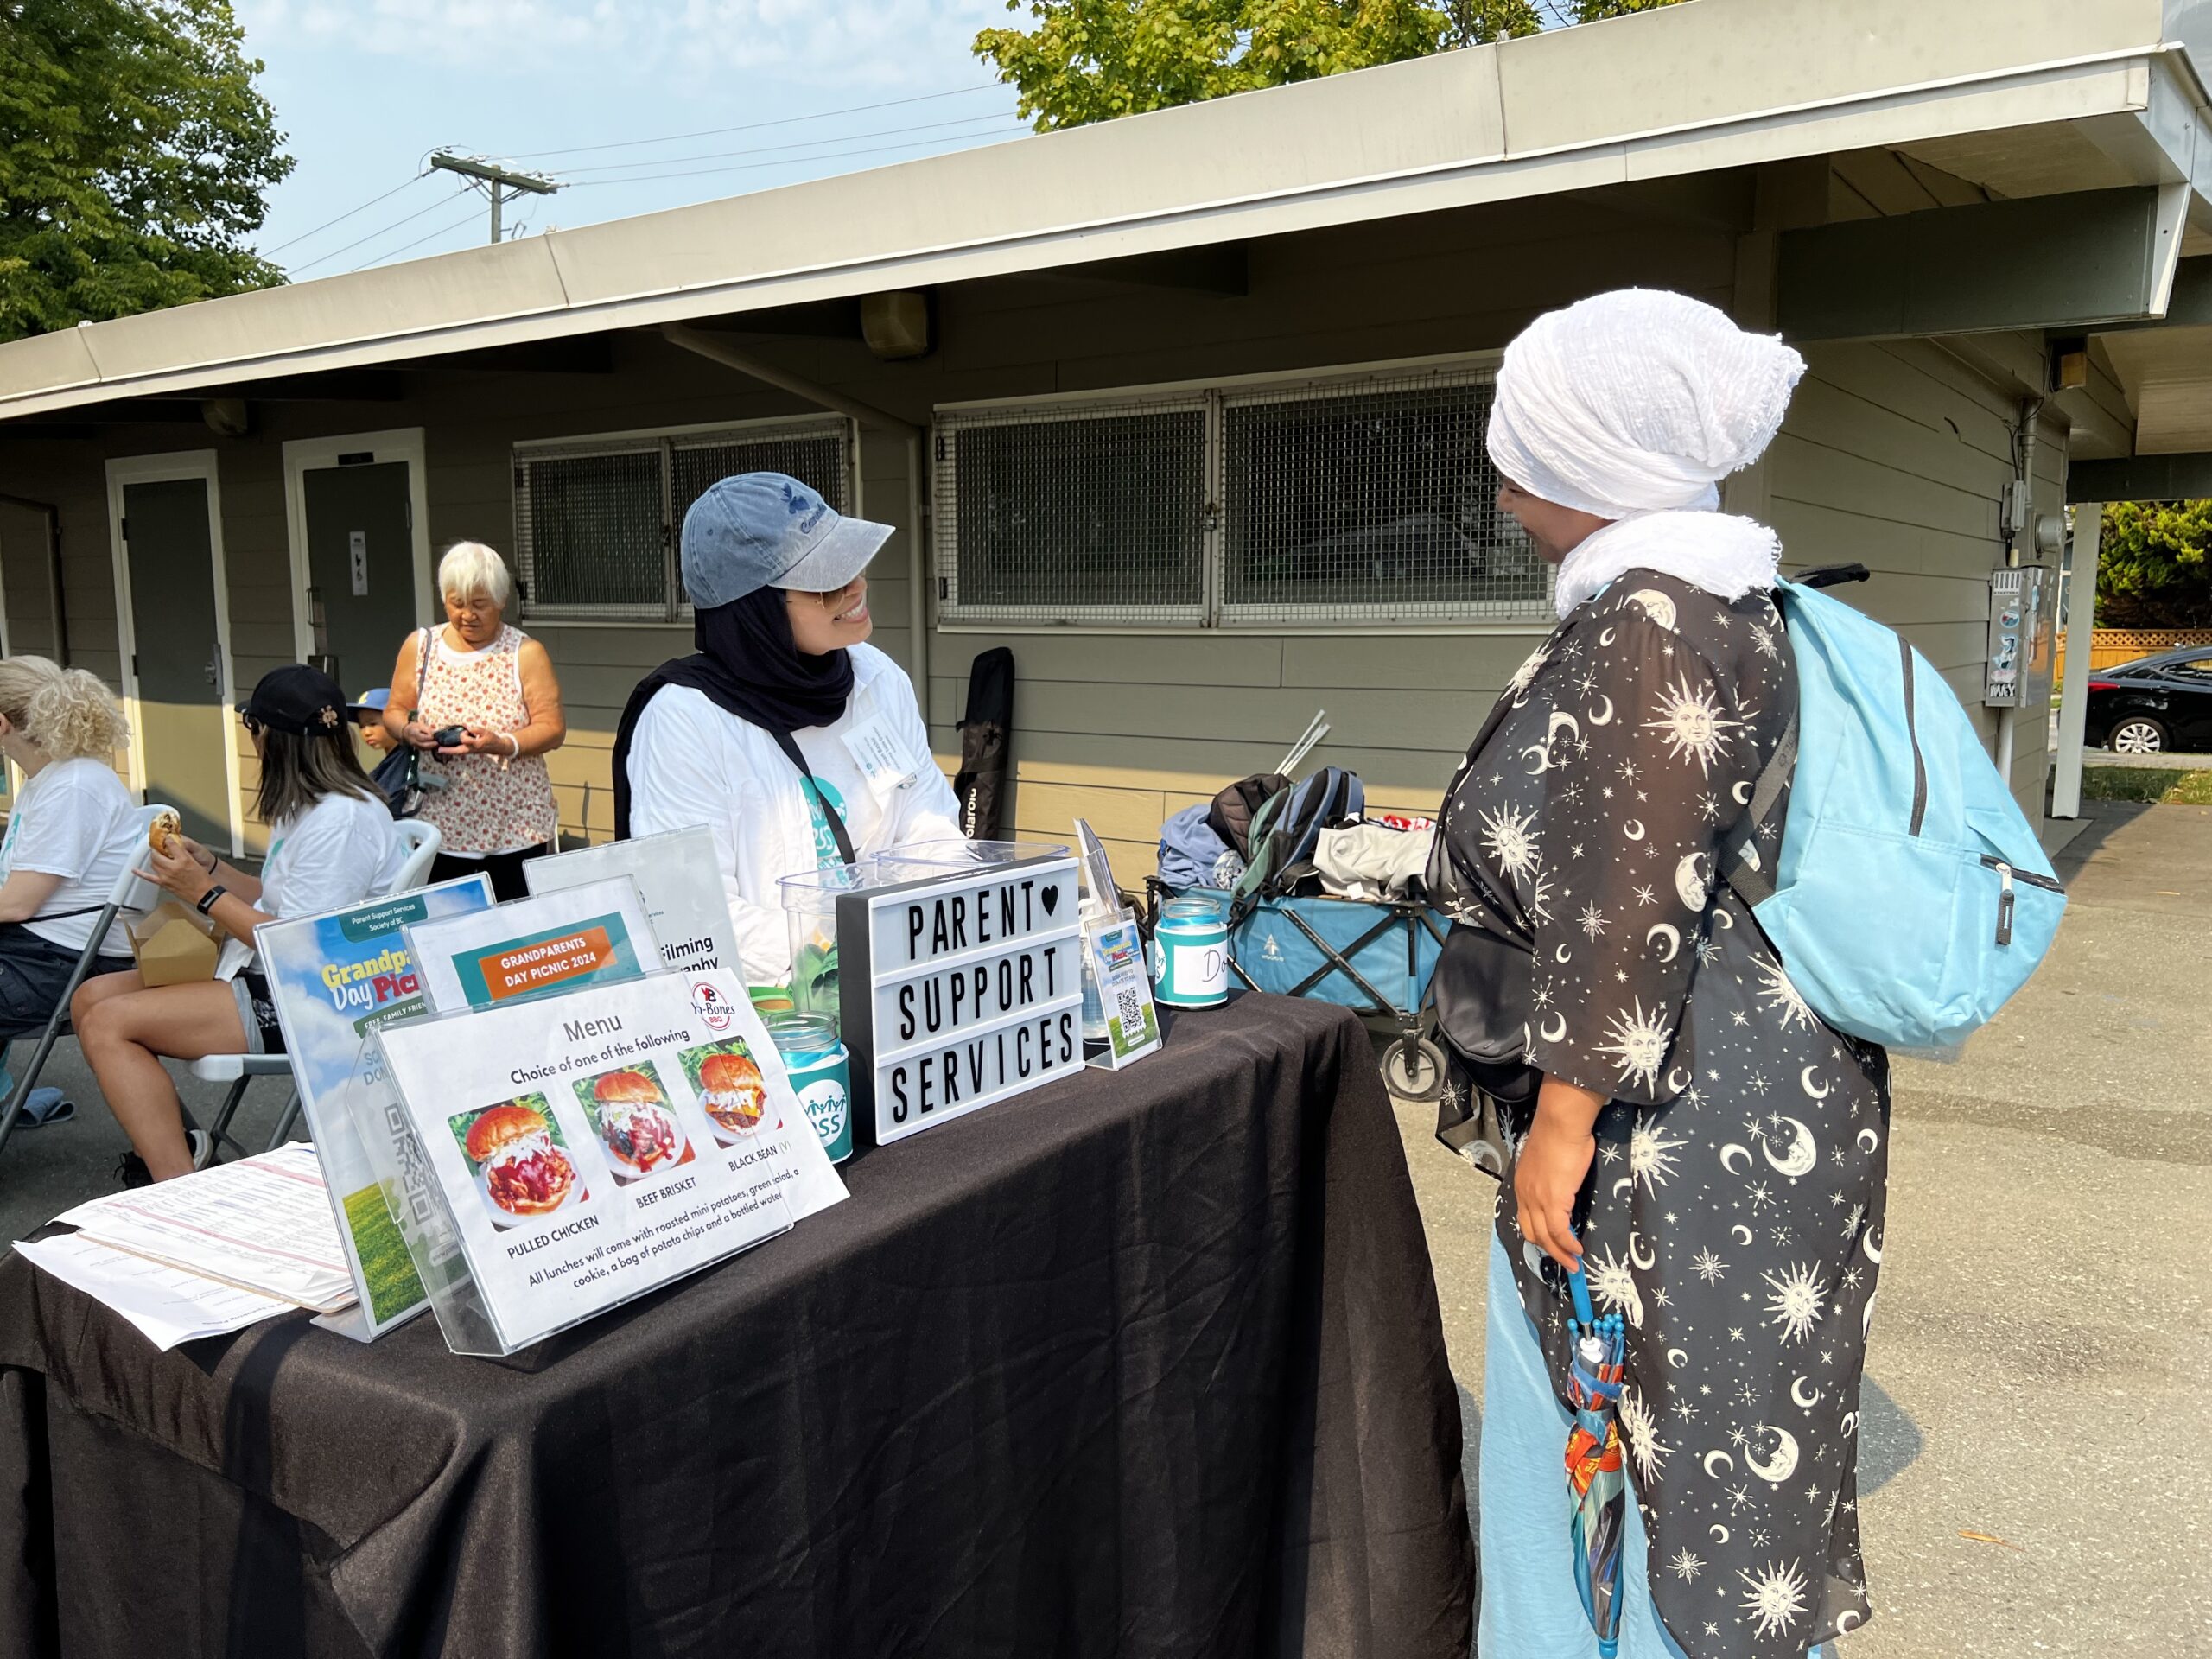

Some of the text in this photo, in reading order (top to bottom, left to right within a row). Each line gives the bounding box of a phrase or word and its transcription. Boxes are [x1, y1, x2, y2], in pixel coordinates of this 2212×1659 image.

[966, 788, 977, 839] olaroi
[352, 904, 416, 925] Parent Support Services
[369, 921, 390, 932] Society
[908, 880, 1034, 960] PARENT
[501, 937, 587, 969] GRANDPARENTS
[505, 951, 597, 988] DAY PICNIC 2024
[1202, 949, 1228, 982] Do
[330, 982, 374, 1011] Day
[899, 947, 1057, 1041] SUPPORT
[383, 1008, 408, 1021] FAMILY
[563, 1015, 623, 1042] Menu
[709, 1015, 723, 1024] BBQ
[511, 1029, 690, 1084] Choice of one of the following
[892, 1013, 1073, 1123] SERVICES
[728, 1140, 792, 1172] BLACK BEAN (V)
[636, 1177, 697, 1209] BEEF BRISKET
[506, 1215, 600, 1260] PULLED CHICKEN
[529, 1271, 544, 1287] All
[543, 1258, 584, 1281] lunches
[585, 1246, 605, 1262] will
[606, 1239, 632, 1255] come
[632, 1227, 655, 1243] with
[655, 1211, 690, 1234] roasted
[690, 1203, 709, 1219] mini
[710, 1190, 749, 1213] potatoes,
[748, 1179, 772, 1197] green
[573, 1192, 783, 1288] cookie, a bag of potato chips and a bottled water
